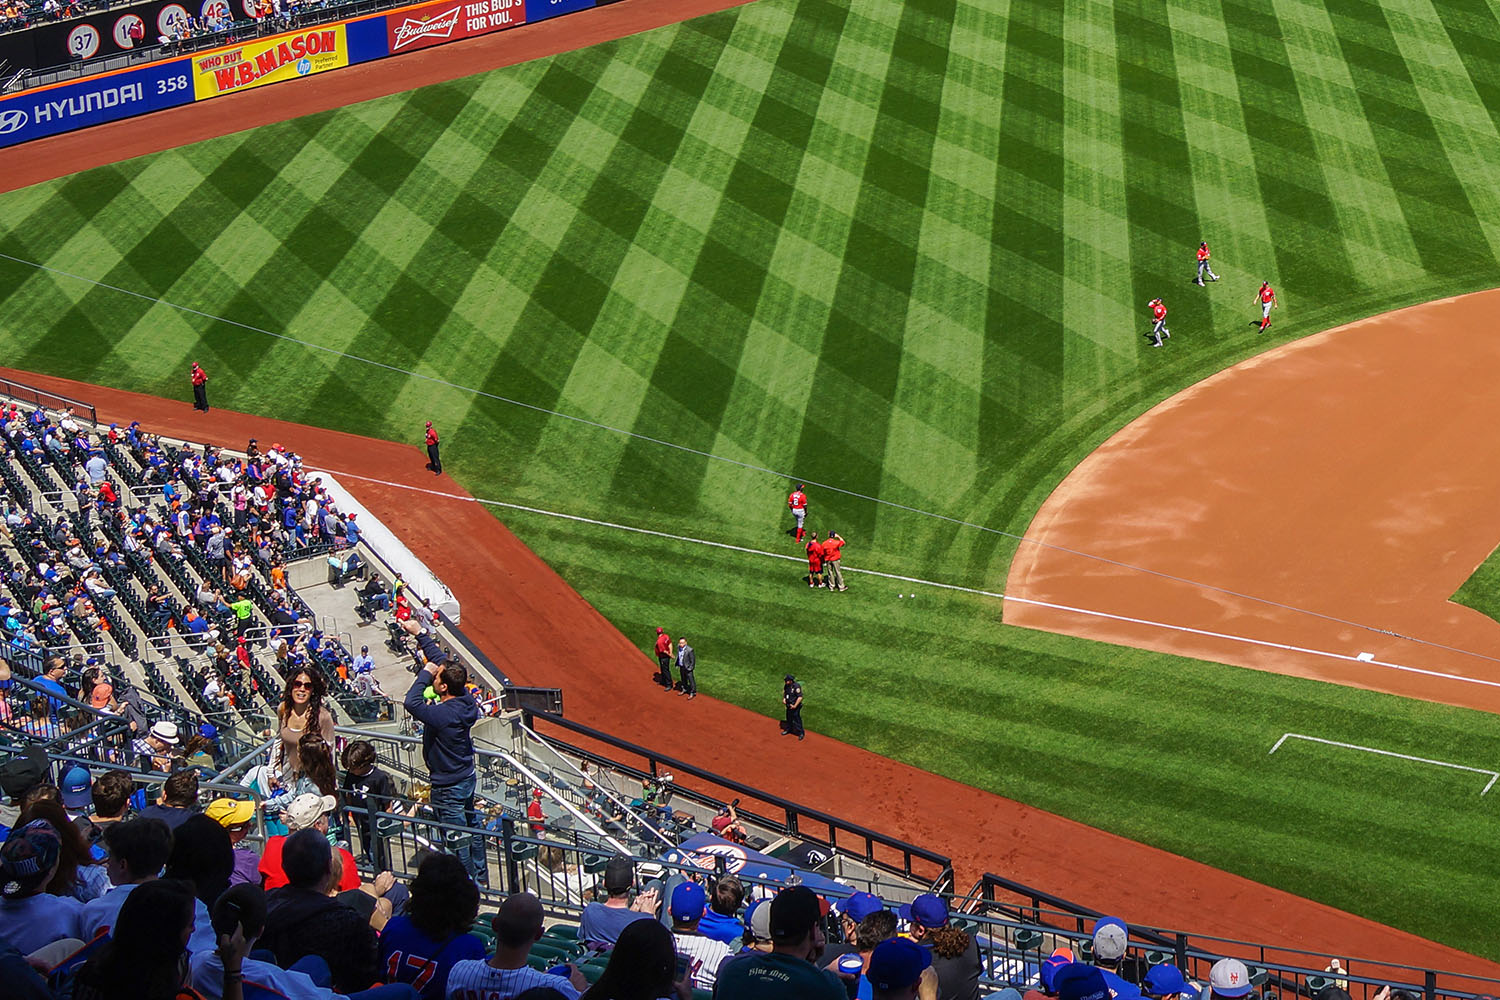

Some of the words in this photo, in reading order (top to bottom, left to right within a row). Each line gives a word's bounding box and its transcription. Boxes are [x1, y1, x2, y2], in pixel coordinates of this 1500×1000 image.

[465, 2, 490, 18] THIS
[394, 15, 459, 39] Budweiser
[466, 16, 488, 32] FOR
[489, 10, 513, 27] YOU.
[74, 33, 93, 51] 37
[199, 58, 222, 71] WHO
[224, 51, 242, 64] BUT
[298, 59, 310, 76] hp
[156, 75, 188, 96] 358
[34, 82, 143, 124] HYUNDAI
[387, 949, 438, 992] 17
